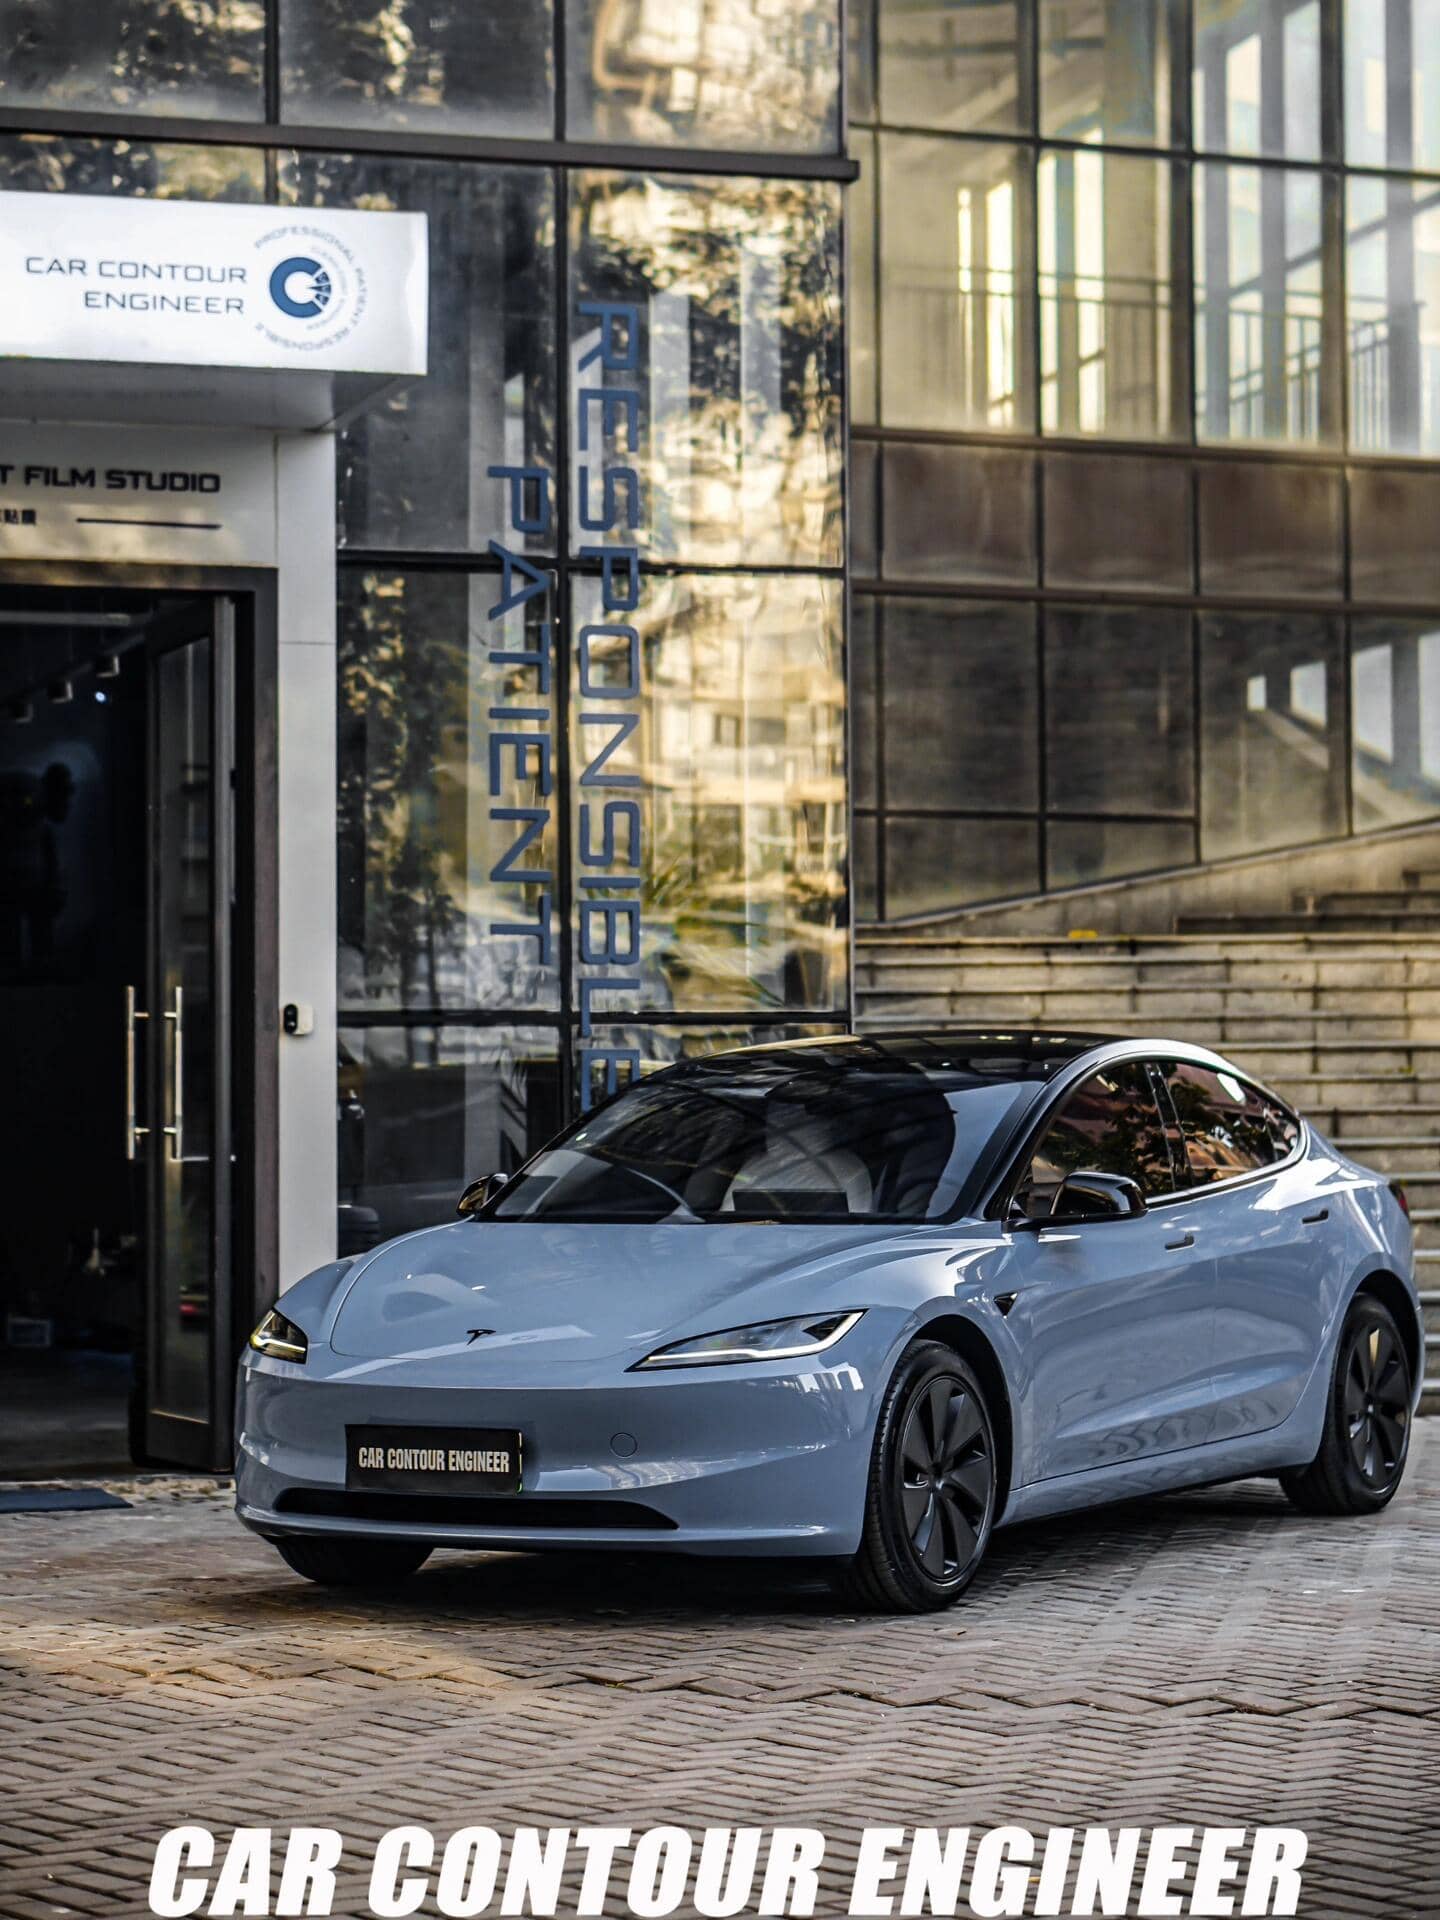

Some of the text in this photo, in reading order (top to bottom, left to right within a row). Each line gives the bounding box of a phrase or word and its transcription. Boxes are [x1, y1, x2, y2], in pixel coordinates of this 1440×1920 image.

[26, 257, 247, 283] CAR CONTOUR
[254, 226, 354, 264] PROFESSIONAL
[351, 268, 367, 326] PATIENT
[84, 291, 244, 314] ENGINEER
[24, 465, 96, 488] FILM
[105, 469, 221, 493] STUDIO
[487, 466, 552, 965] PATIENT
[578, 303, 640, 1113] RESPONSIBLE
[359, 1447, 510, 1473] CAR CONTOUR ENGINEER
